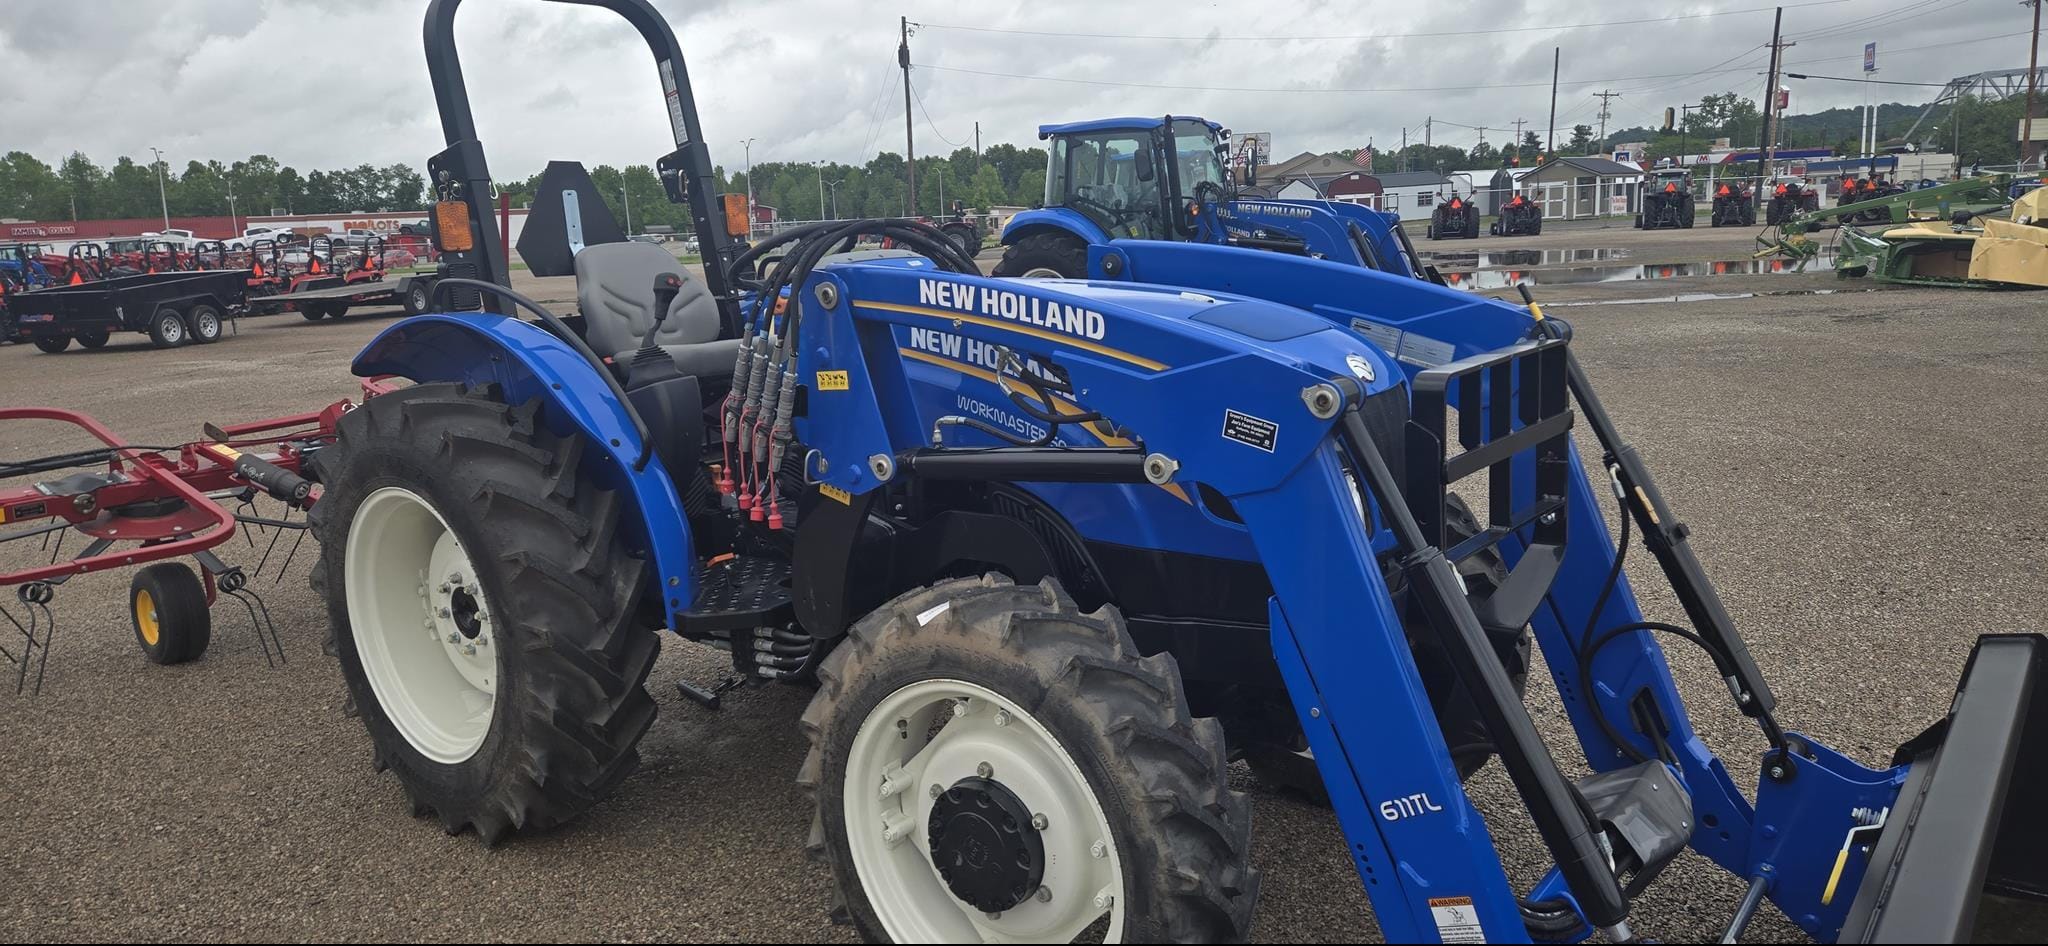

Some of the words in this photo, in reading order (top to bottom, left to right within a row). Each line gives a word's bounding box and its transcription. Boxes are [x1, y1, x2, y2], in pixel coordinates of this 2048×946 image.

[1237, 203, 1261, 215] NEW
[1263, 205, 1312, 218] HOLLAND
[920, 278, 975, 311] NEW
[981, 287, 1106, 341] HOLLAND
[910, 326, 962, 359] NEW
[957, 394, 1047, 441] WORKMASTER
[1379, 792, 1443, 821] 611TL
